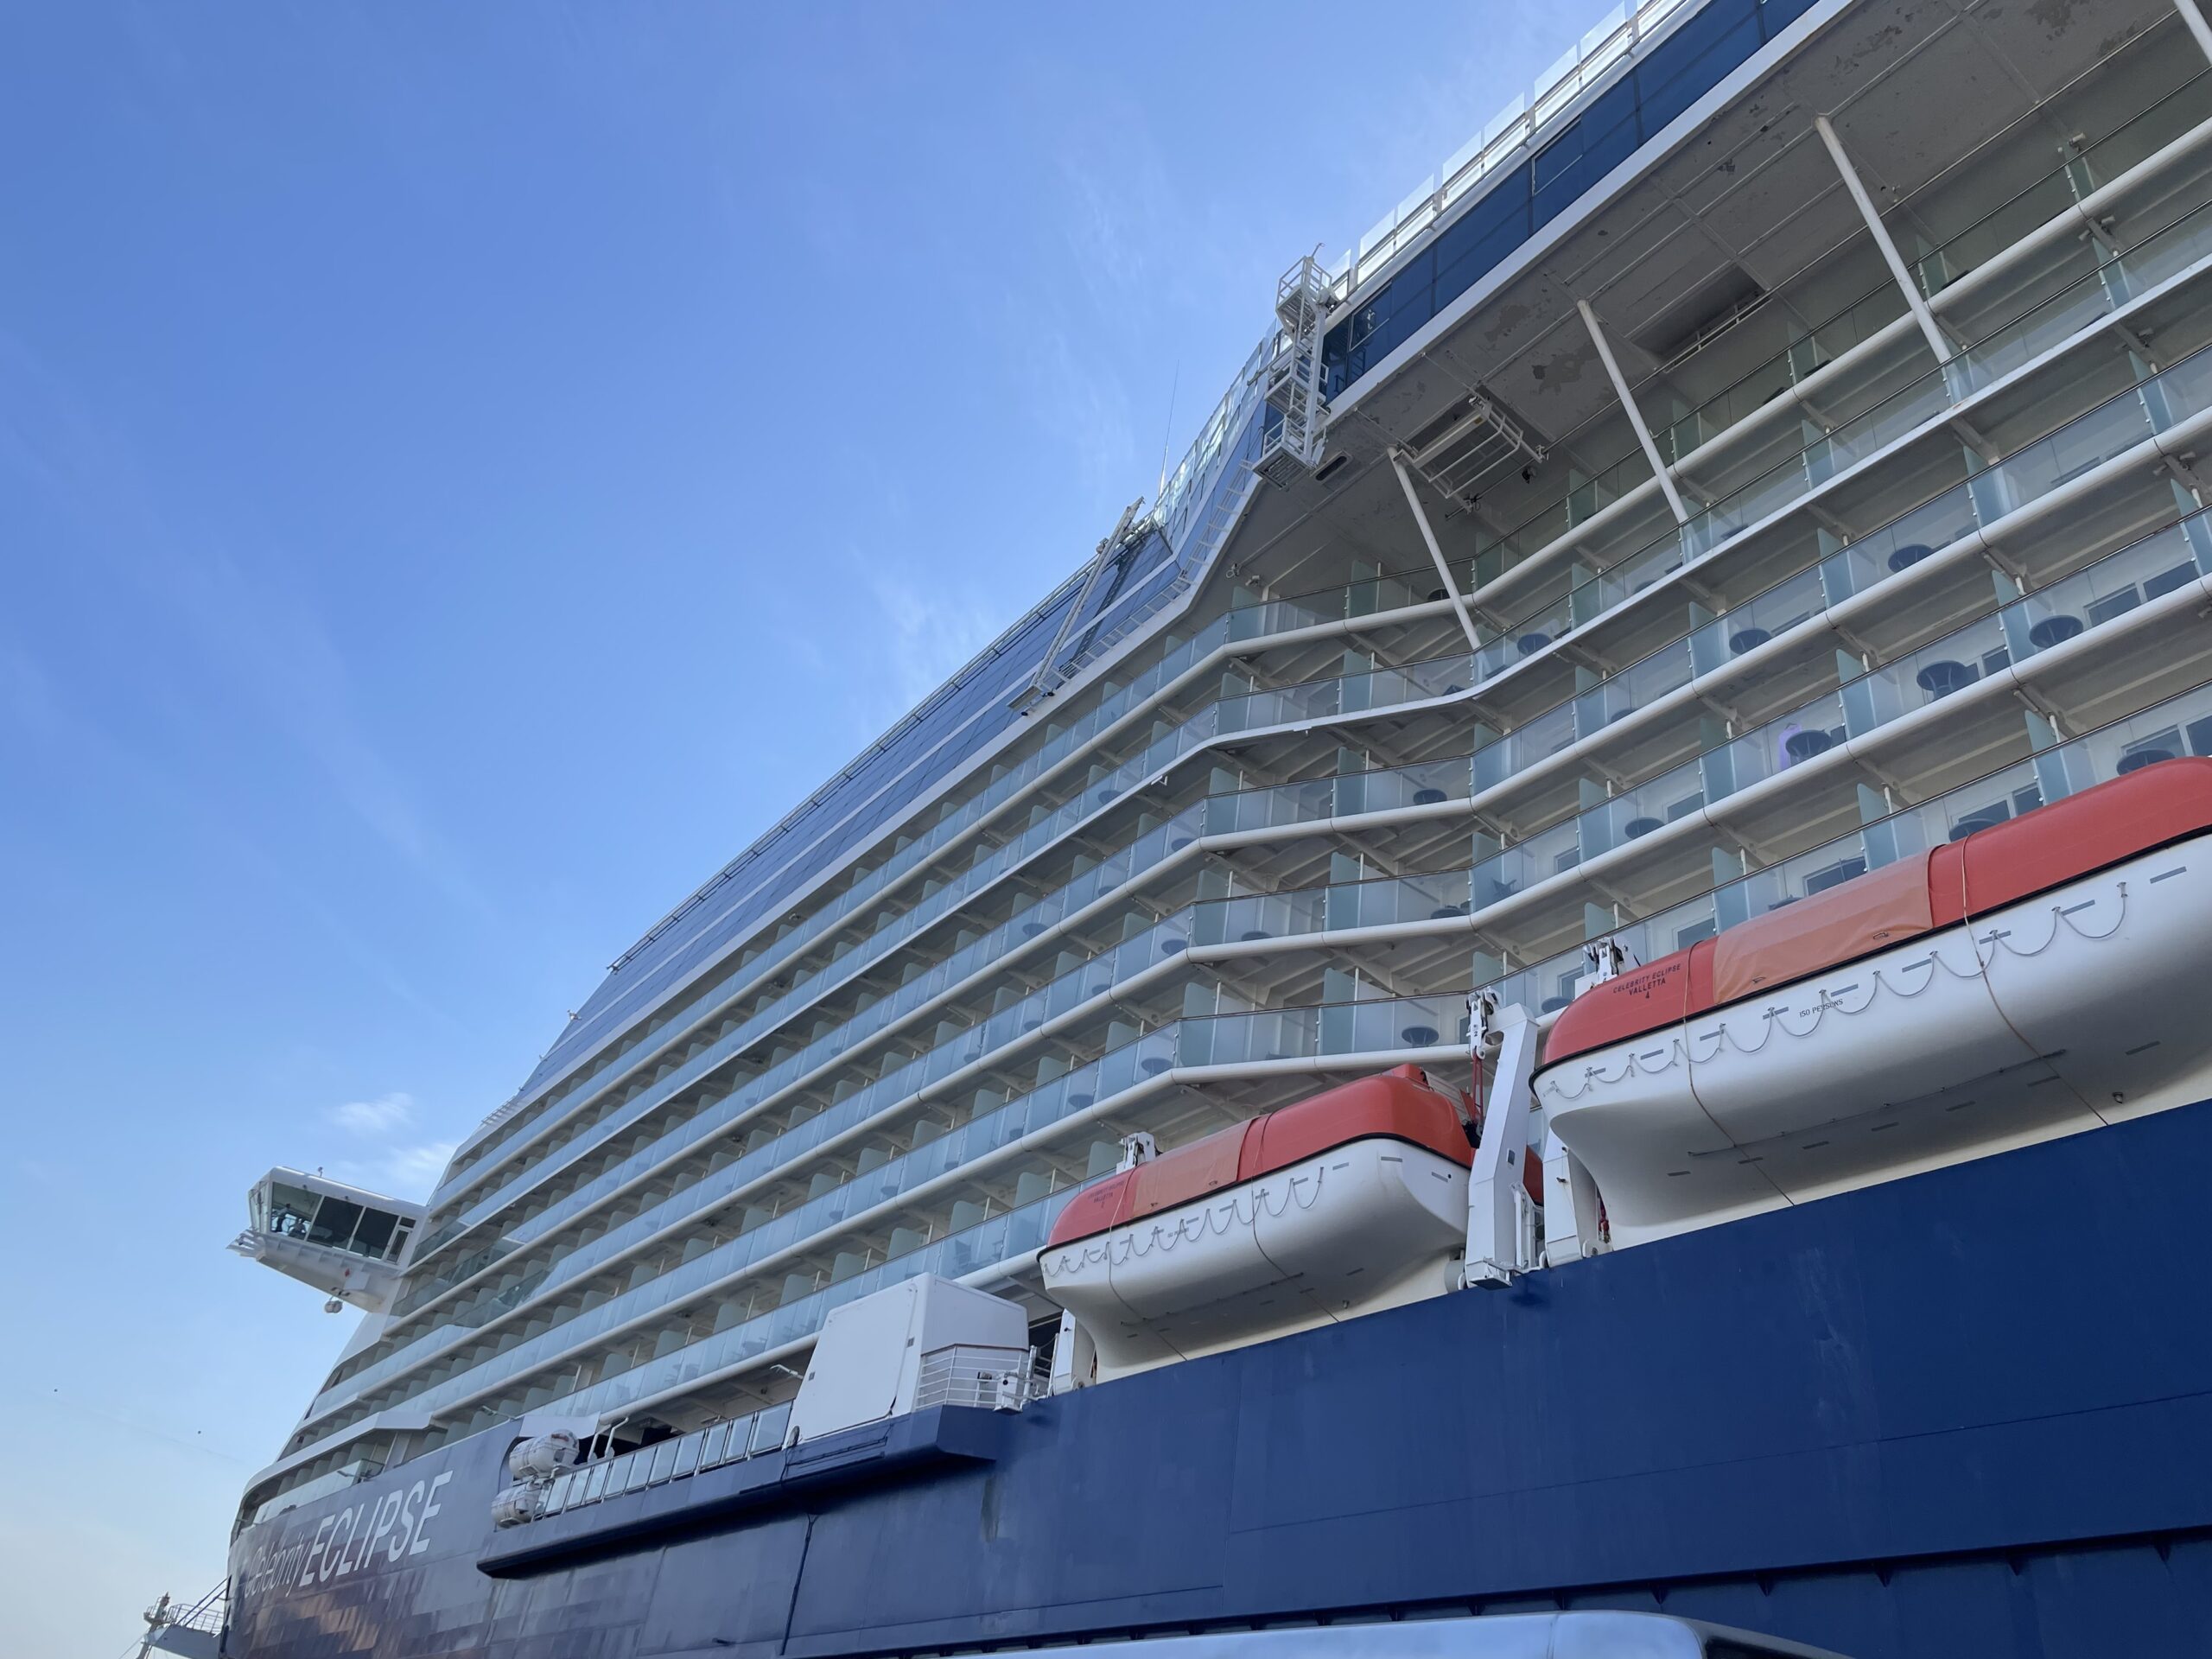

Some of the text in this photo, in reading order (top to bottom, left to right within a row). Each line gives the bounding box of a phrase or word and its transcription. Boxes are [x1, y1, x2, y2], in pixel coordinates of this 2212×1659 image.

[1612, 963, 1681, 994] CELEBRITY ECLIPSE
[1629, 977, 1666, 996] VALLETTA
[1799, 1008, 1811, 1018] 150
[244, 1470, 454, 1599] Celebrity ECLIPSE
